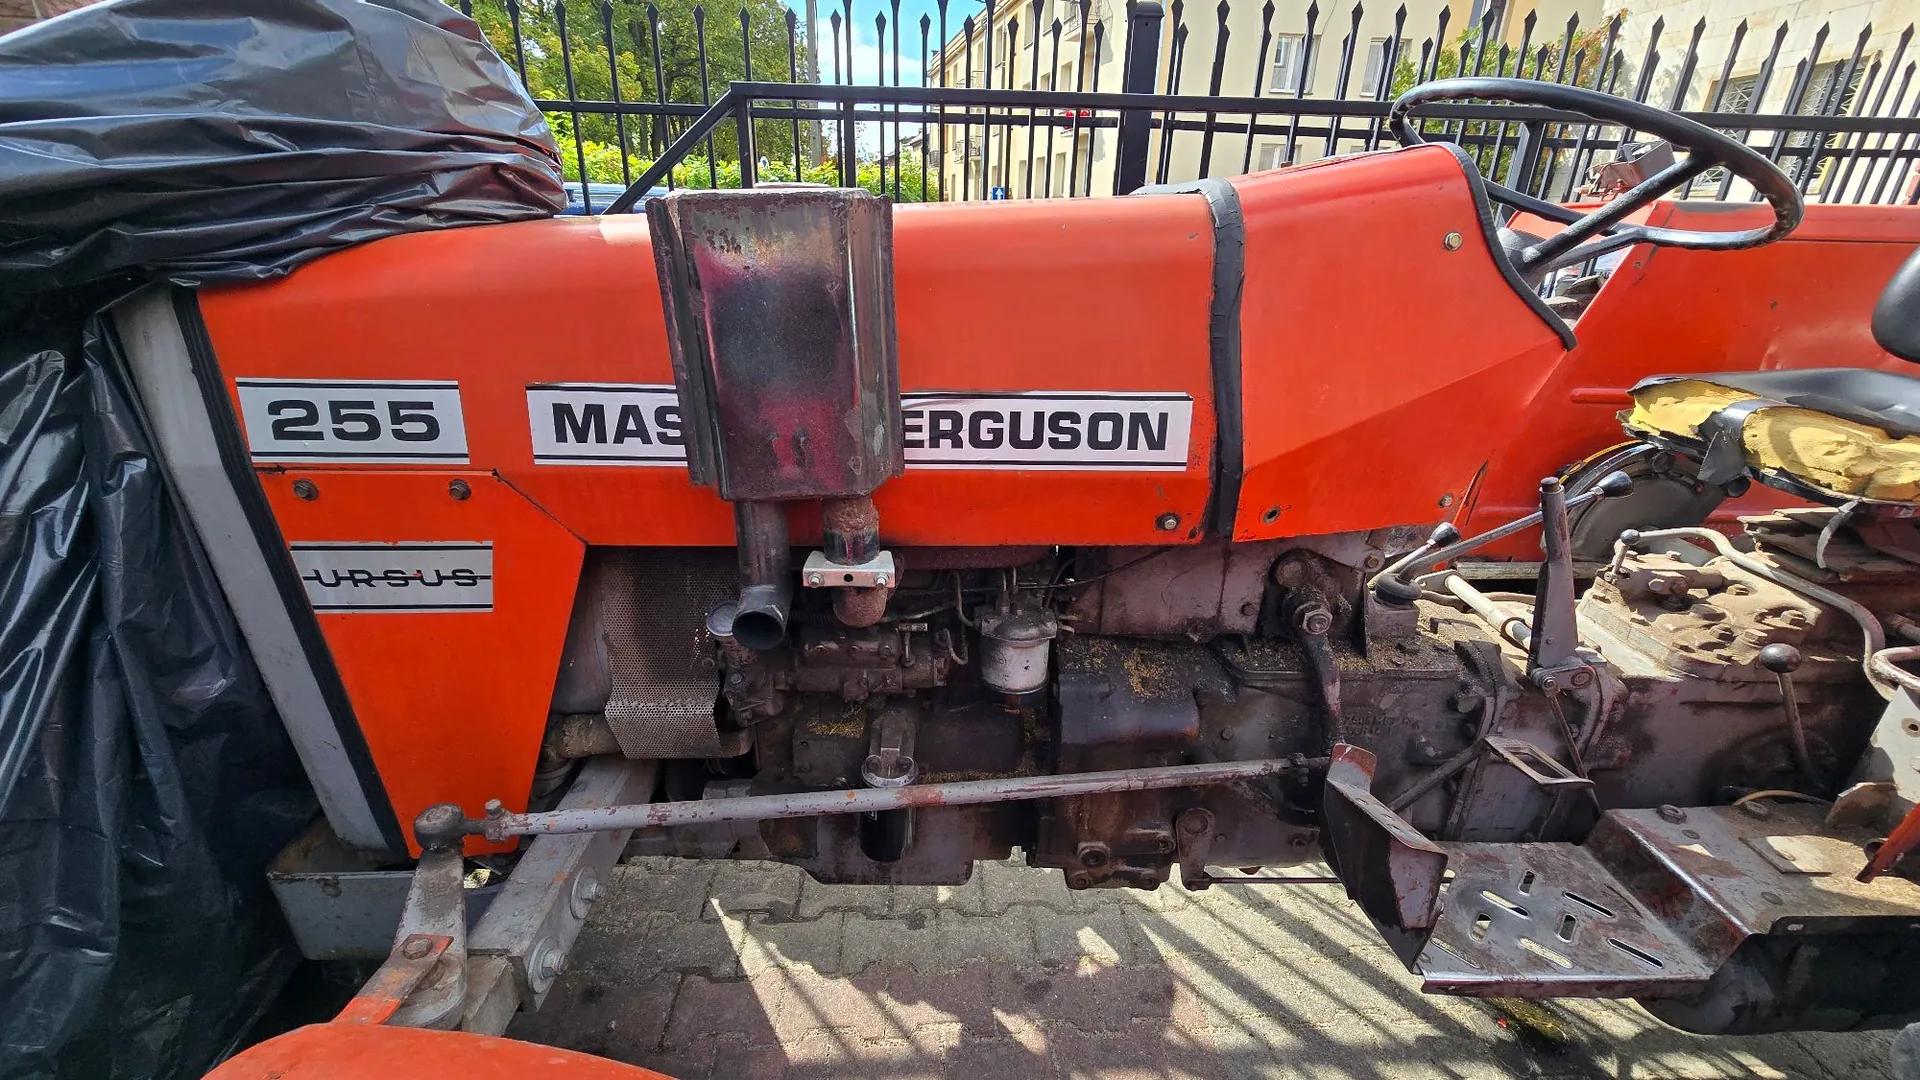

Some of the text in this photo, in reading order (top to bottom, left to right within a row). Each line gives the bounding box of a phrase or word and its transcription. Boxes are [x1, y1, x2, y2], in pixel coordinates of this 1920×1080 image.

[267, 399, 441, 441] 255
[552, 402, 1169, 450] MAS ERGUSON
[313, 569, 478, 588] URSUS
